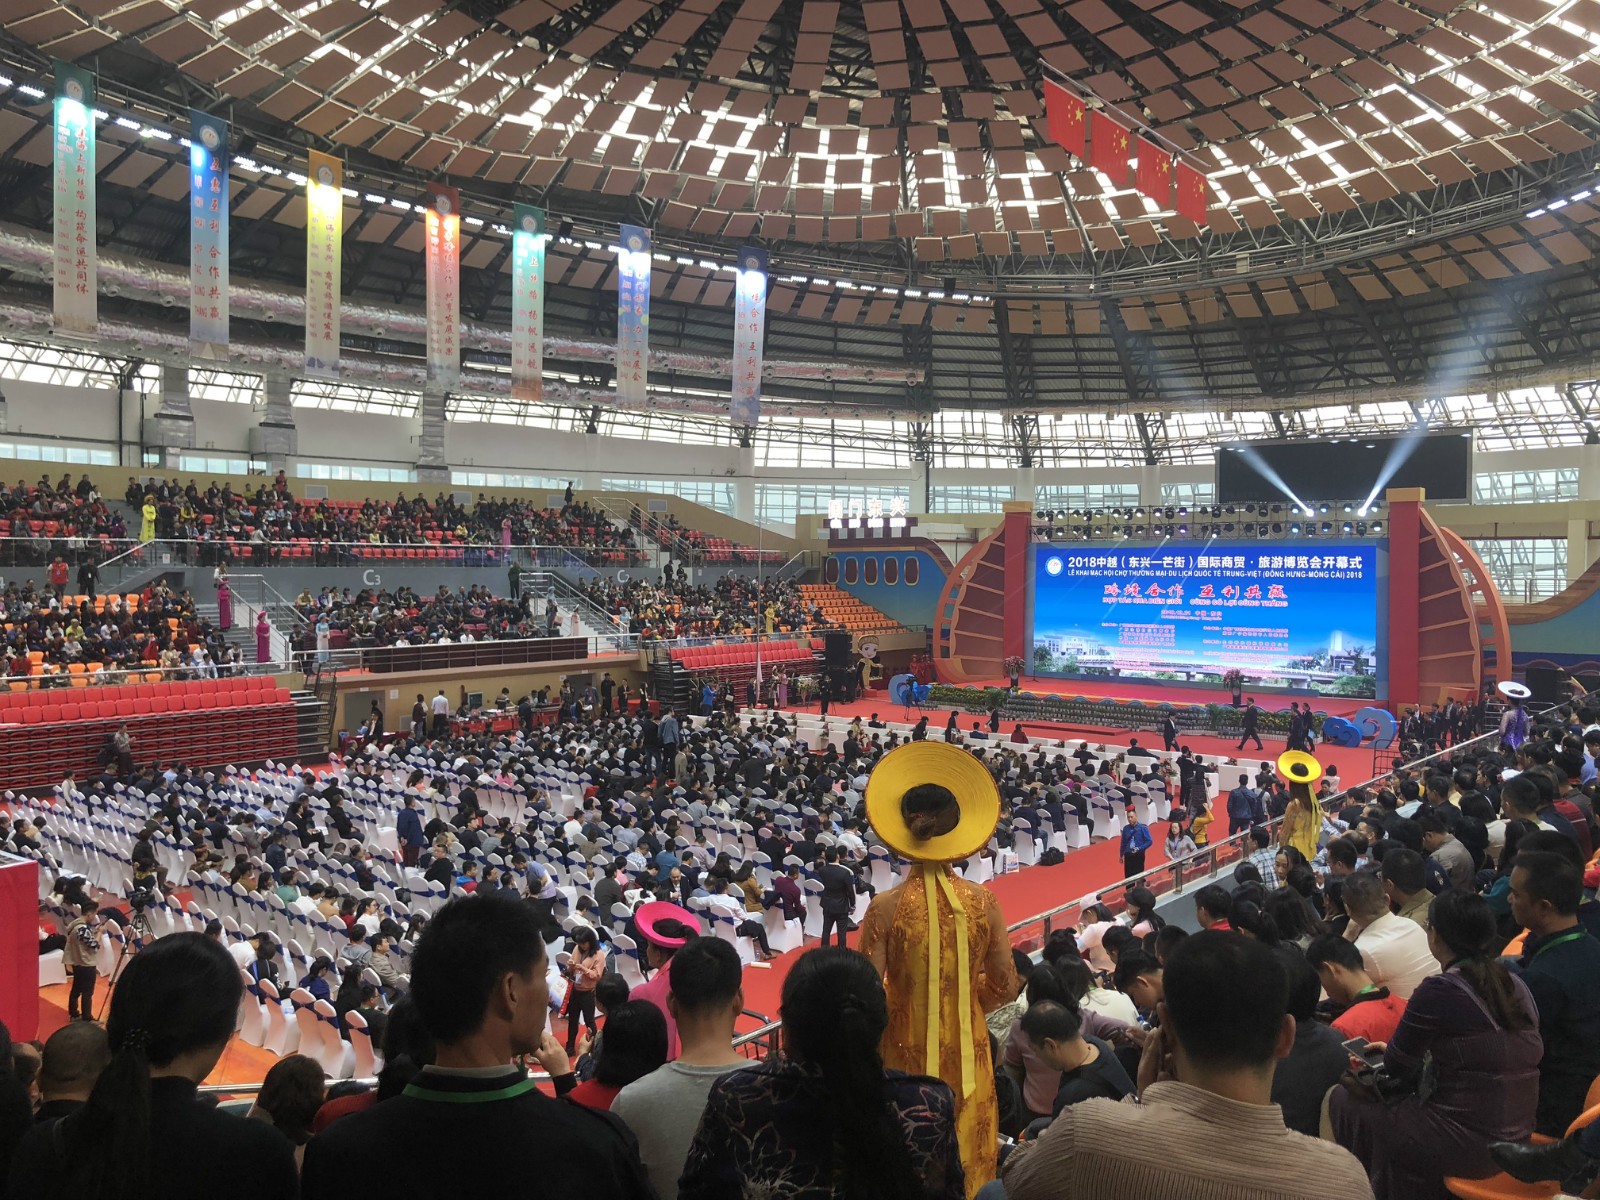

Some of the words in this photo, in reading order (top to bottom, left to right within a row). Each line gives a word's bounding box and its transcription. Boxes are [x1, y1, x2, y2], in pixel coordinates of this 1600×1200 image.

[208, 245, 222, 321] 合作共赢
[828, 496, 906, 519] 国门东兴
[363, 569, 382, 586] C3
[1090, 569, 1103, 577] MẠC
[1103, 568, 1114, 577] HỘI
[1114, 569, 1128, 577] CHỢ
[1178, 570, 1193, 578] LỊCH
[1346, 571, 1363, 579] 2018
[1103, 582, 1184, 598] 跨境合作
[1198, 584, 1288, 600] 互利共赢
